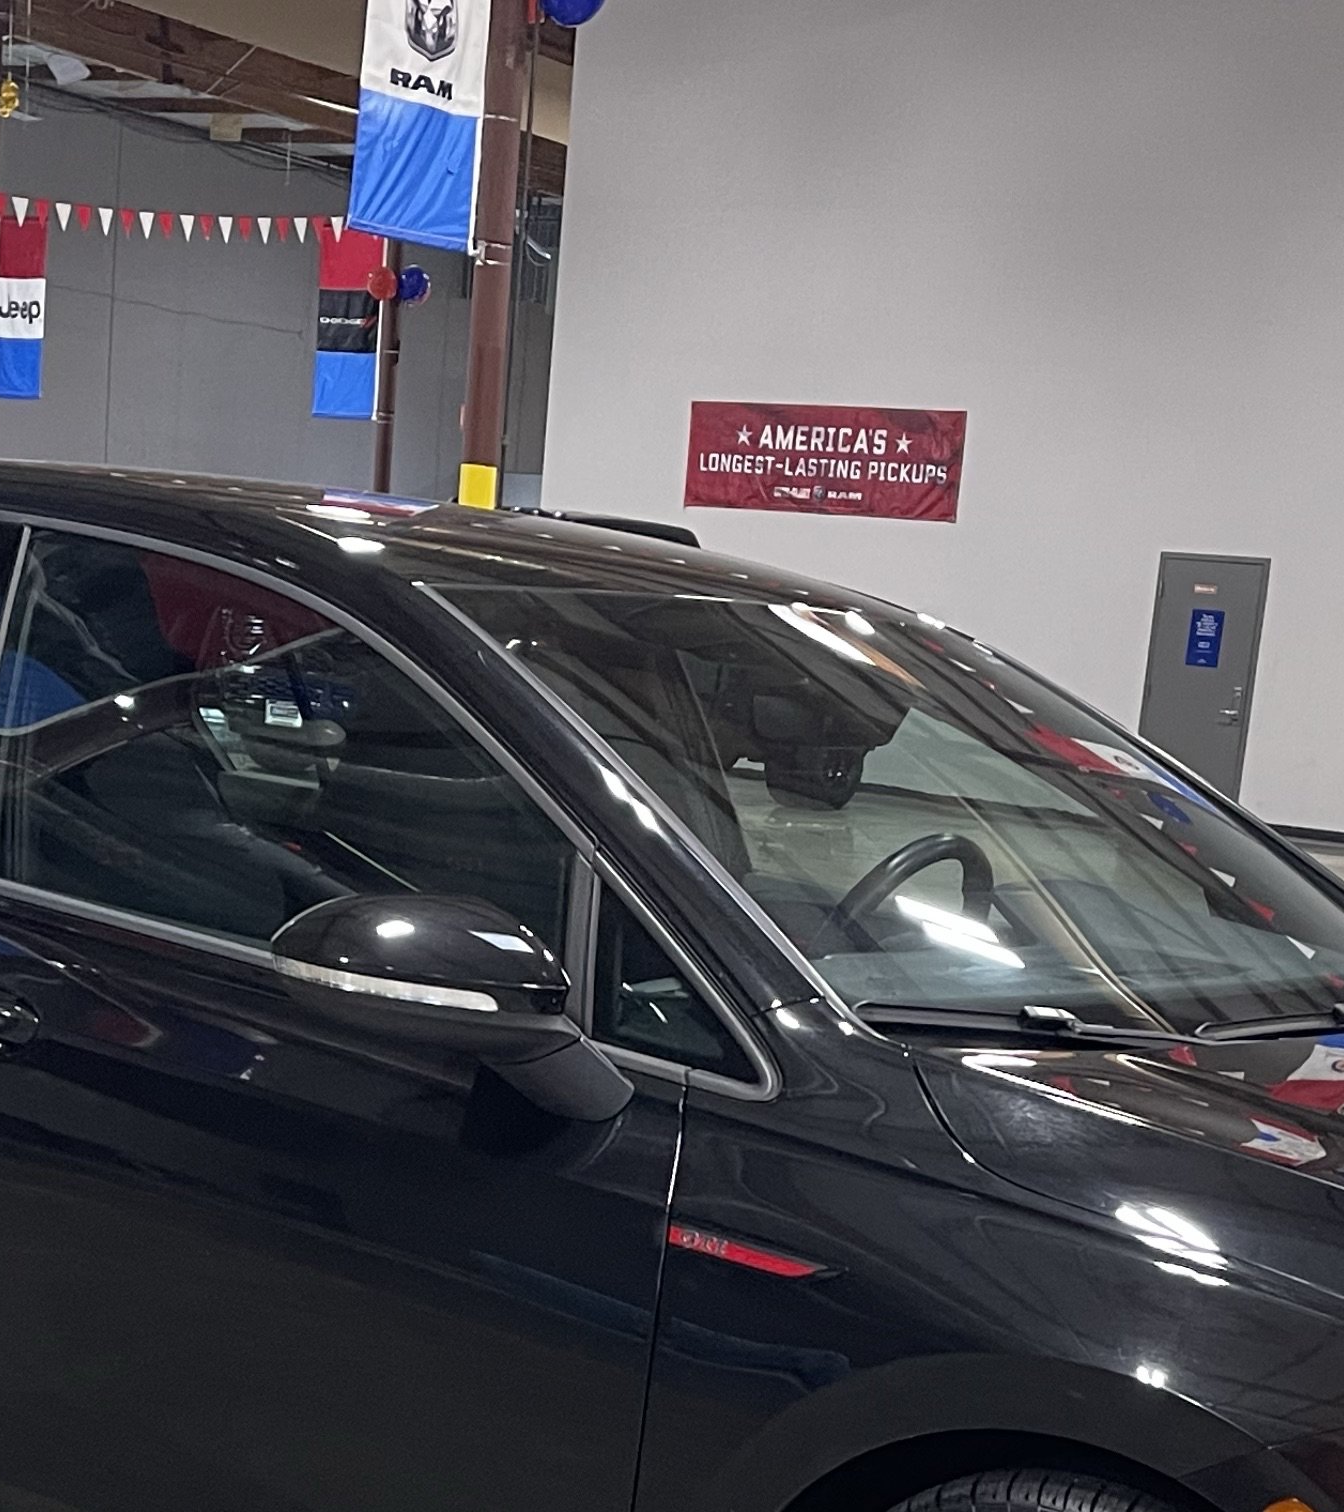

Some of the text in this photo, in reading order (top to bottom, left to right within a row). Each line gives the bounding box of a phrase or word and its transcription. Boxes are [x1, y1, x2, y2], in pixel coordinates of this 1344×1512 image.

[389, 67, 454, 101] RAM
[758, 424, 888, 456] AMERICA'S
[699, 452, 948, 485] LONGEST-LASTING PICKUPS
[827, 490, 863, 501] RAM
